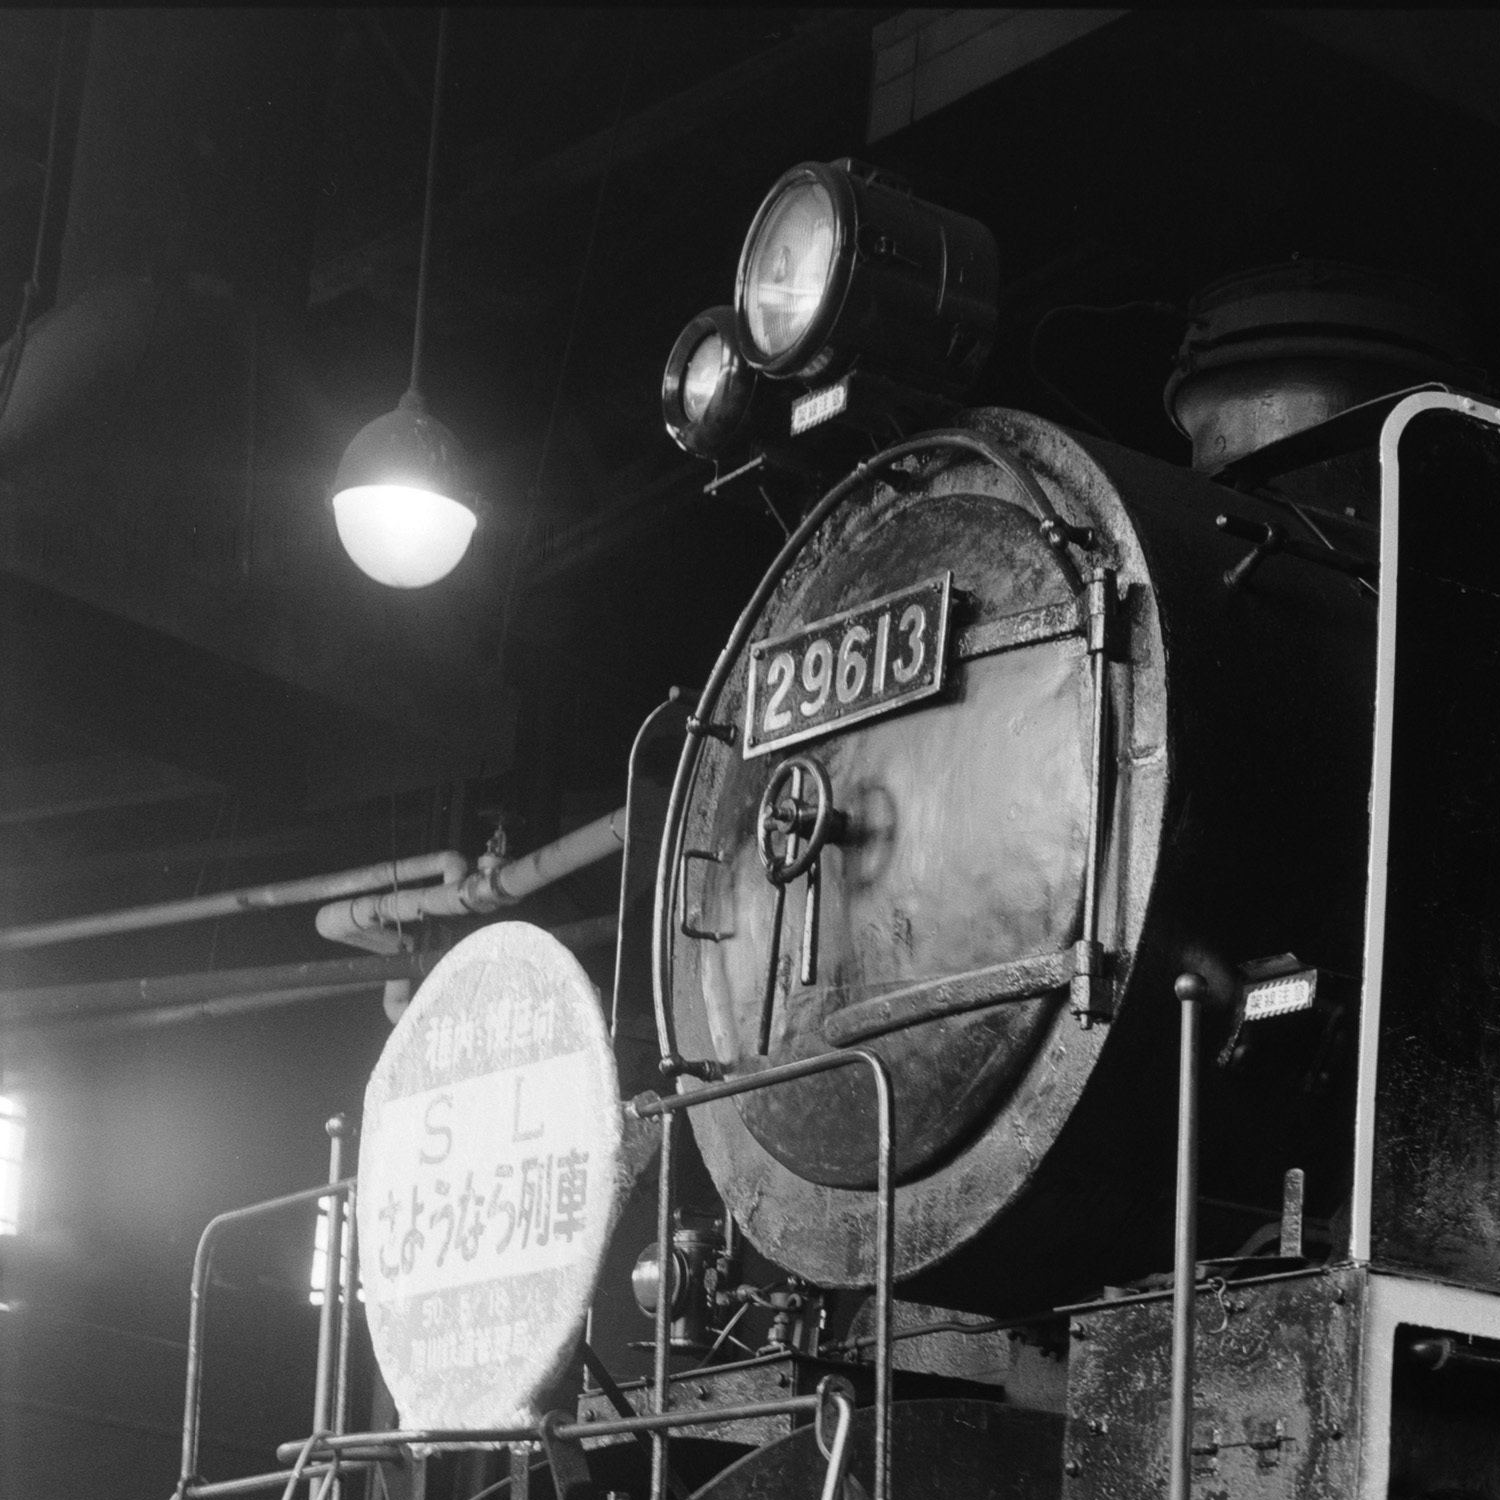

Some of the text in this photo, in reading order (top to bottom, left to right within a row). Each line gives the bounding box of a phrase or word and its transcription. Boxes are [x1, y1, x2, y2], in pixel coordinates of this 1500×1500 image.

[763, 604, 926, 732] 29613
[378, 1147, 590, 1283] さようなら列車
